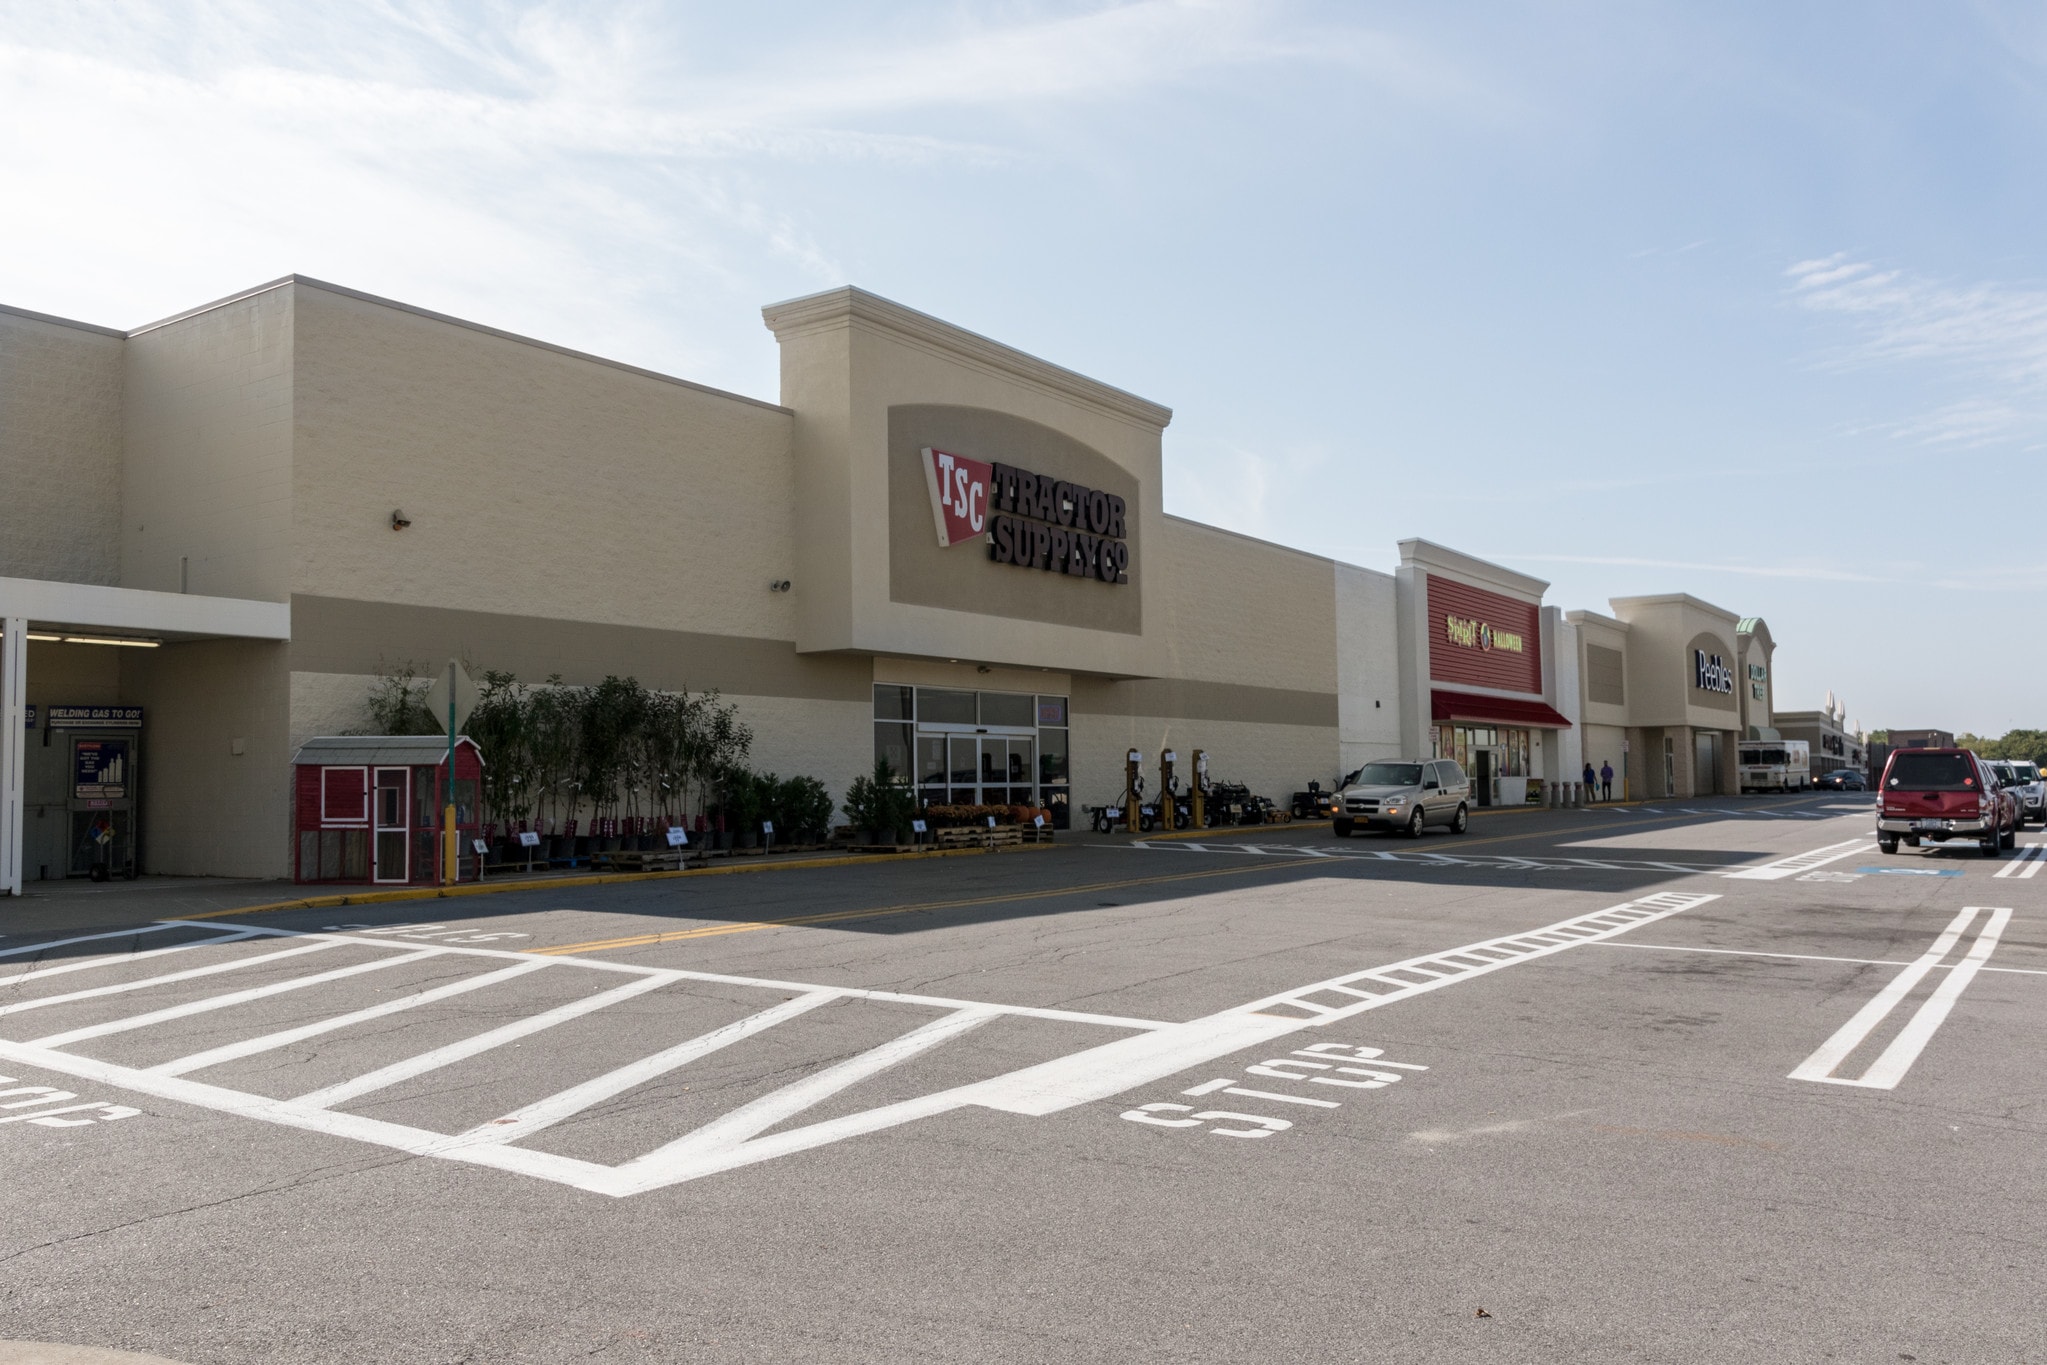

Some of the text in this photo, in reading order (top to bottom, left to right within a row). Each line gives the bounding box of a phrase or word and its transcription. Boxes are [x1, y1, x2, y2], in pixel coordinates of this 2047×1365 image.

[939, 453, 983, 532] TSC
[992, 462, 1126, 539] TRACTOR
[989, 515, 1097, 578] SUPPLY
[1697, 649, 1732, 694] Peebles
[50, 709, 141, 718] WELDING GAS TO GO!
[1120, 1043, 1430, 1138] STOP
